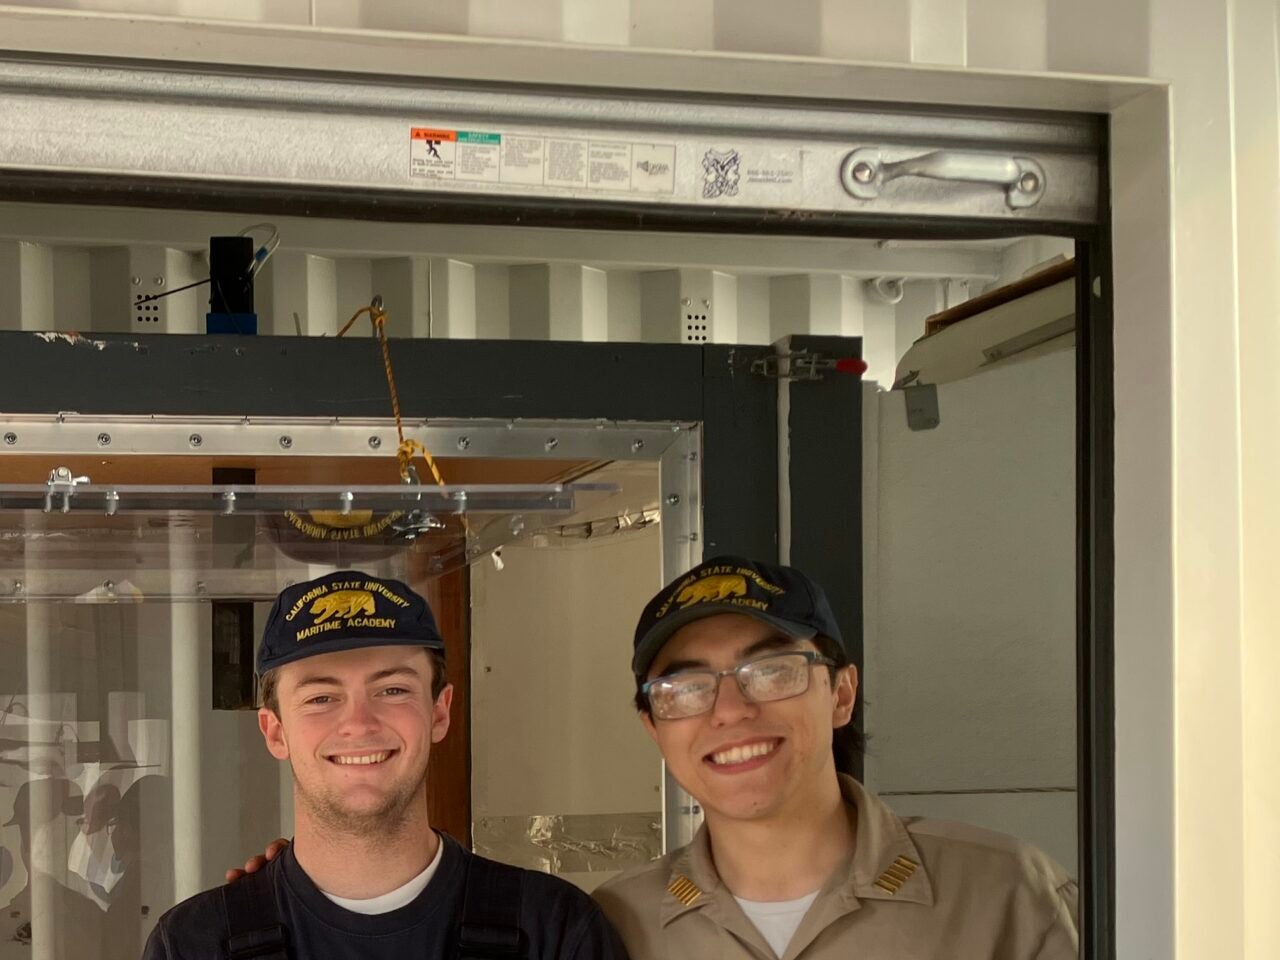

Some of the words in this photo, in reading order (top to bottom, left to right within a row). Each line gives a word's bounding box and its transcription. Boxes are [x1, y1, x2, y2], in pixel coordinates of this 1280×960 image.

[700, 565, 732, 577] STATE
[285, 584, 328, 622] CALIFORNIA
[332, 580, 361, 590] STATE
[363, 580, 410, 609] UNIVERSITY
[296, 619, 342, 642] MARITIME
[346, 617, 396, 630] ACADEMY
